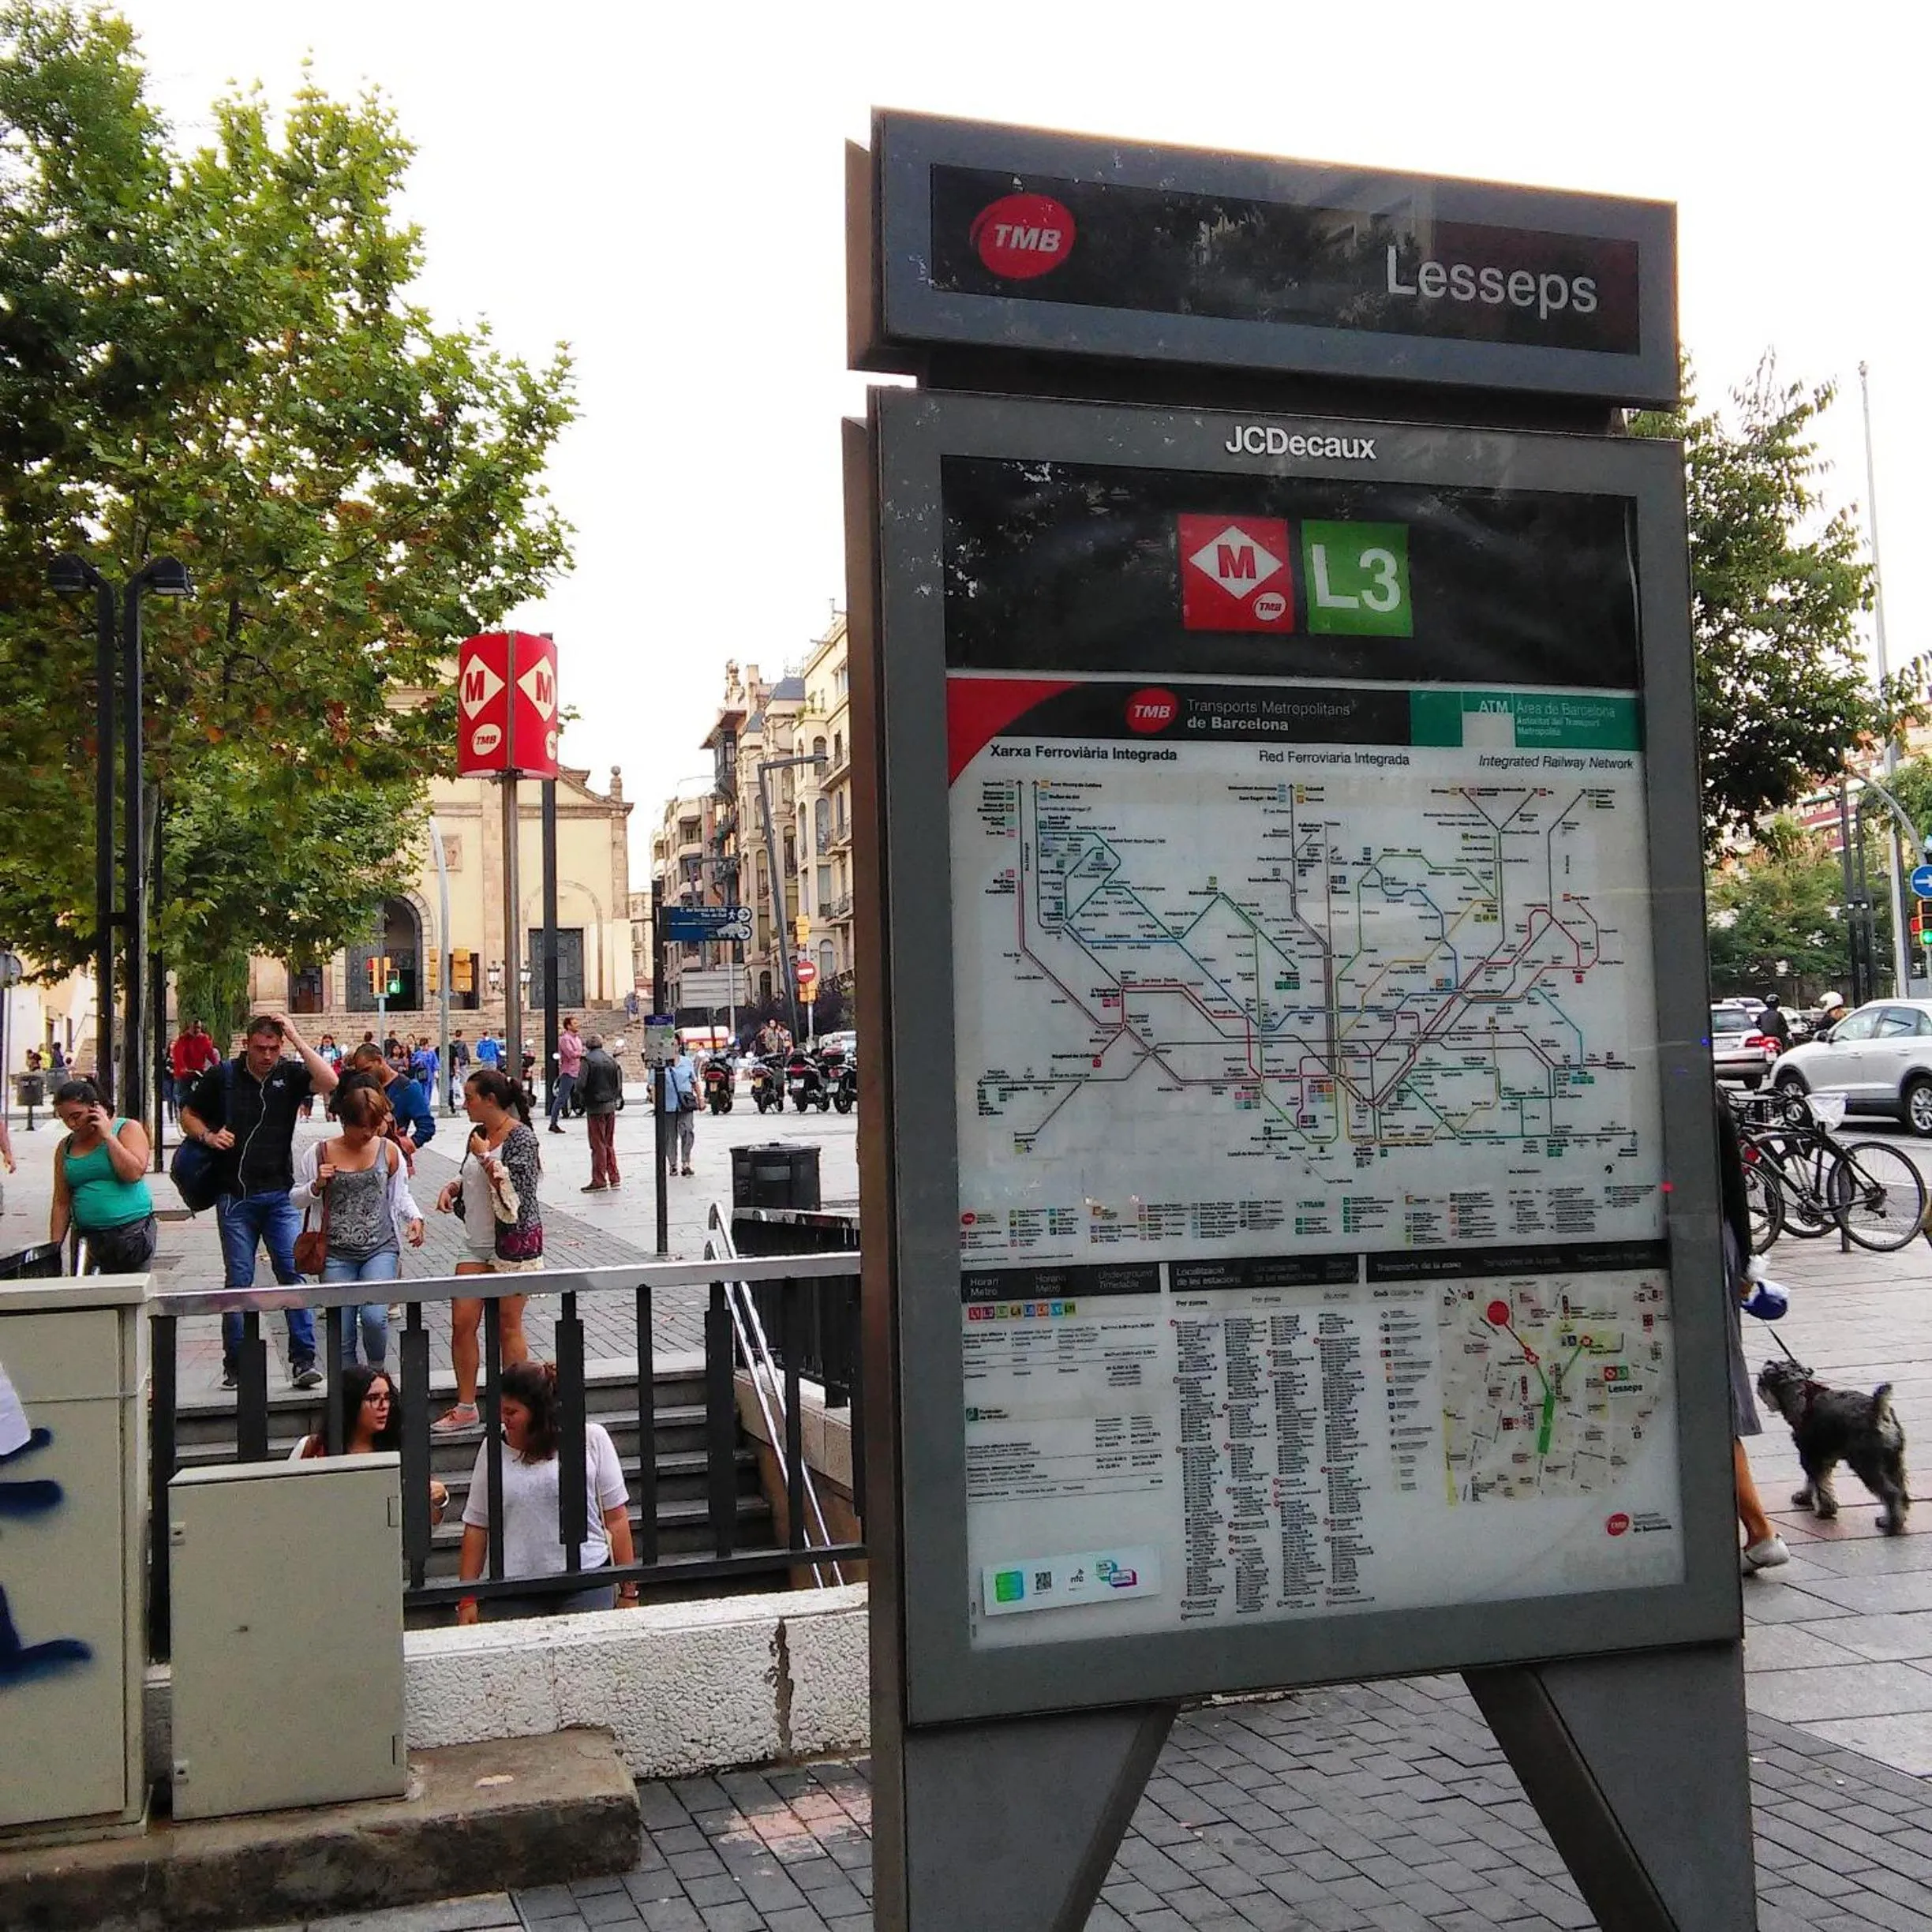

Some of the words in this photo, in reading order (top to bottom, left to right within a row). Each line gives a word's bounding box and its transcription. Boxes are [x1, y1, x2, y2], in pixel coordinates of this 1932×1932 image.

[994, 223, 1062, 253] TMB
[1387, 245, 1598, 320] Lesseps
[1225, 425, 1377, 459] JCDecaux
[1217, 544, 1256, 579] M
[1311, 544, 1402, 613] L3
[1259, 601, 1282, 612] TMB
[465, 670, 485, 703] M
[535, 670, 552, 706] M
[1133, 705, 1171, 719] TMB
[1187, 699, 1258, 714] Transports
[1261, 700, 1351, 717] Metropolitans
[1478, 700, 1508, 713] ATM
[1186, 716, 1207, 728] de
[1211, 716, 1289, 731] Barcelona
[476, 734, 497, 745] TMB
[990, 744, 1032, 758] Xarxa
[1035, 746, 1109, 759] Ferroviària
[1112, 747, 1178, 762] Integrada
[1259, 750, 1284, 762] Red
[1288, 751, 1351, 764] Ferroviaria
[1354, 752, 1410, 767] Integrada
[1479, 754, 1539, 769] Integrated
[1543, 755, 1586, 771] Railway
[1589, 757, 1634, 770] Network
